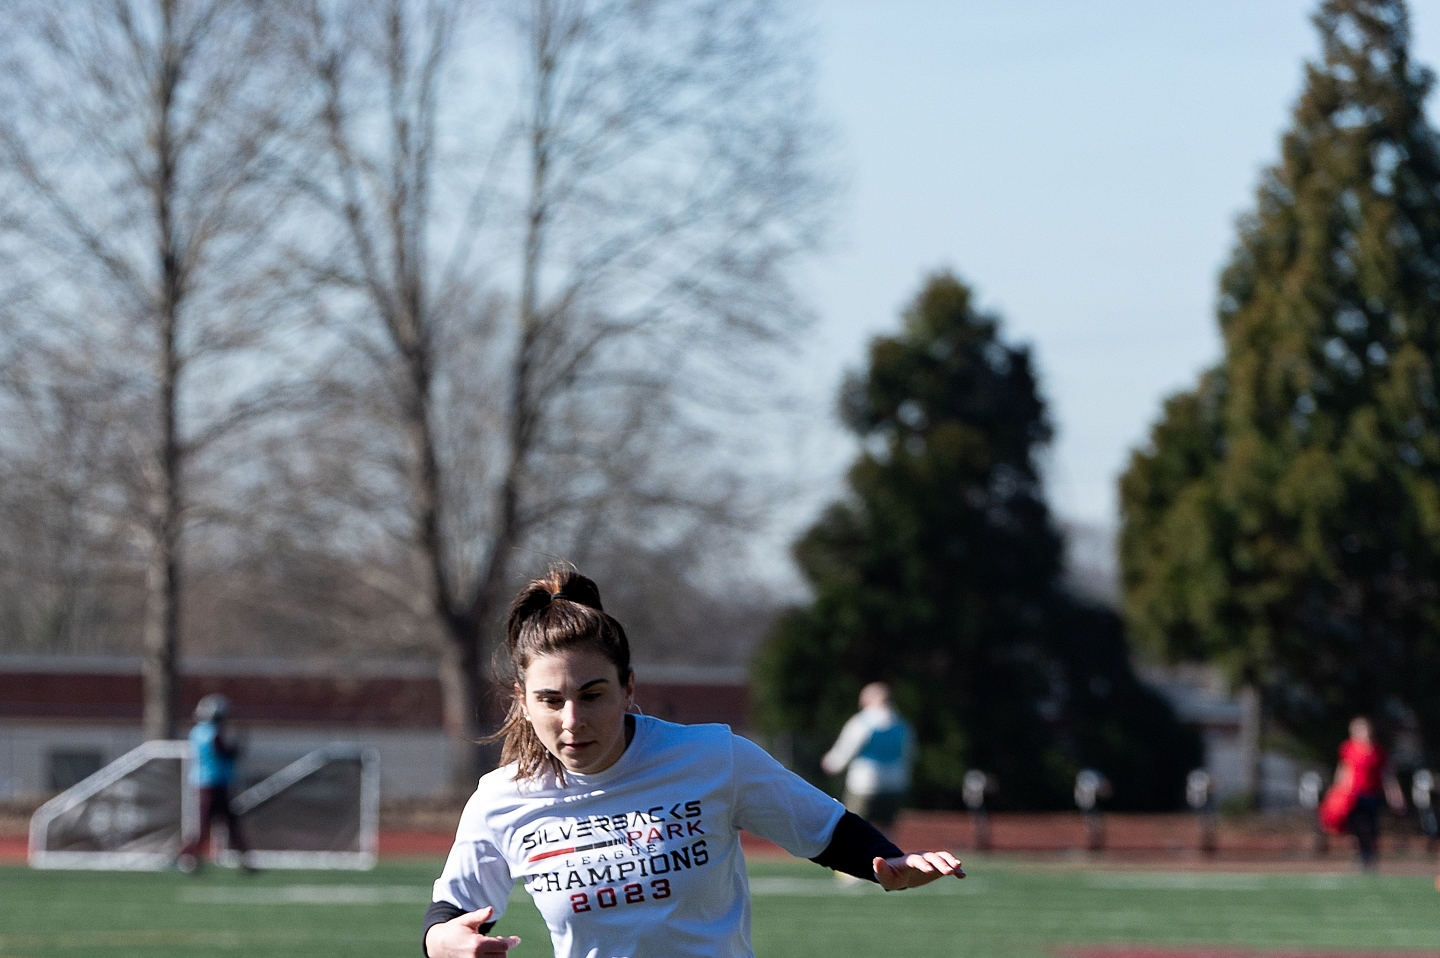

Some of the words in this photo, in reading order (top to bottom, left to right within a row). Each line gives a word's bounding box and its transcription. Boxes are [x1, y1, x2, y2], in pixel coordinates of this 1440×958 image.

[522, 800, 702, 851] SILVERBACKS
[625, 819, 706, 847] PARK
[565, 843, 658, 868] LEAGUE
[570, 878, 672, 914] 2023
